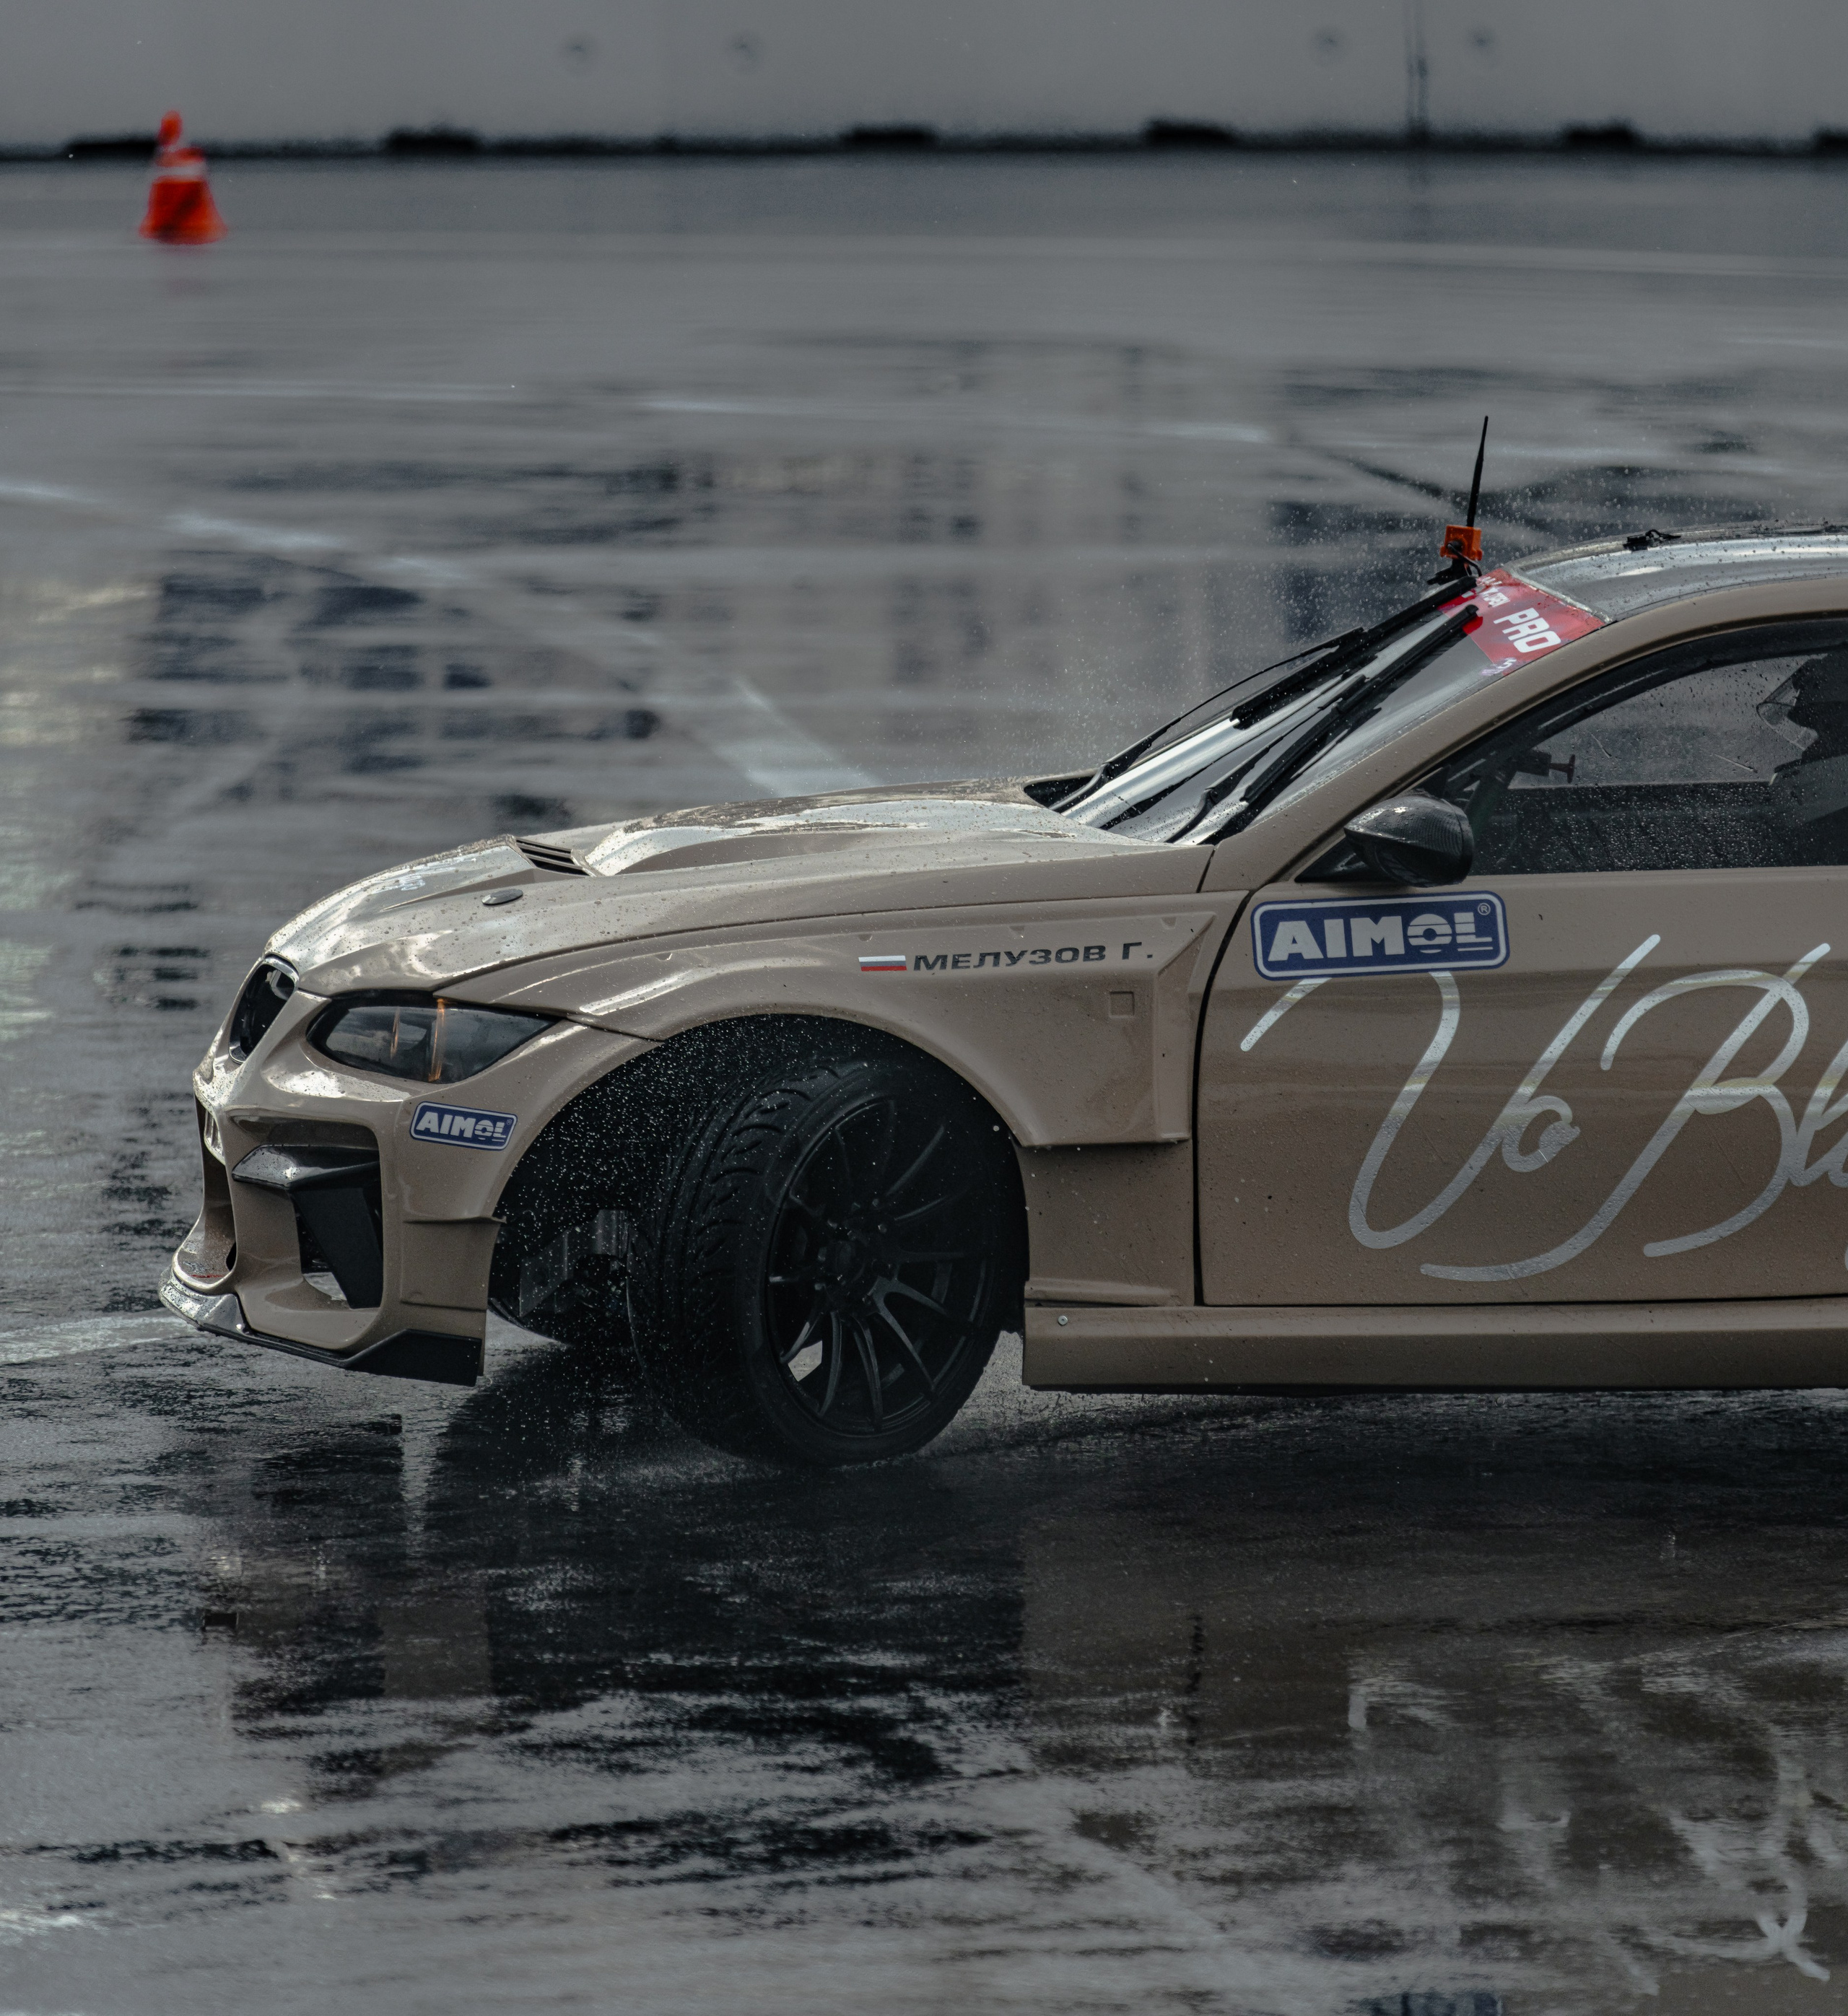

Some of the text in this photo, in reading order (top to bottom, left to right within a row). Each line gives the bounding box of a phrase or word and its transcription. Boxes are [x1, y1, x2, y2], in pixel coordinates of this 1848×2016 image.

[1494, 608, 1561, 653] PRO
[913, 941, 1153, 971] МЕЛУЗОВ Г.
